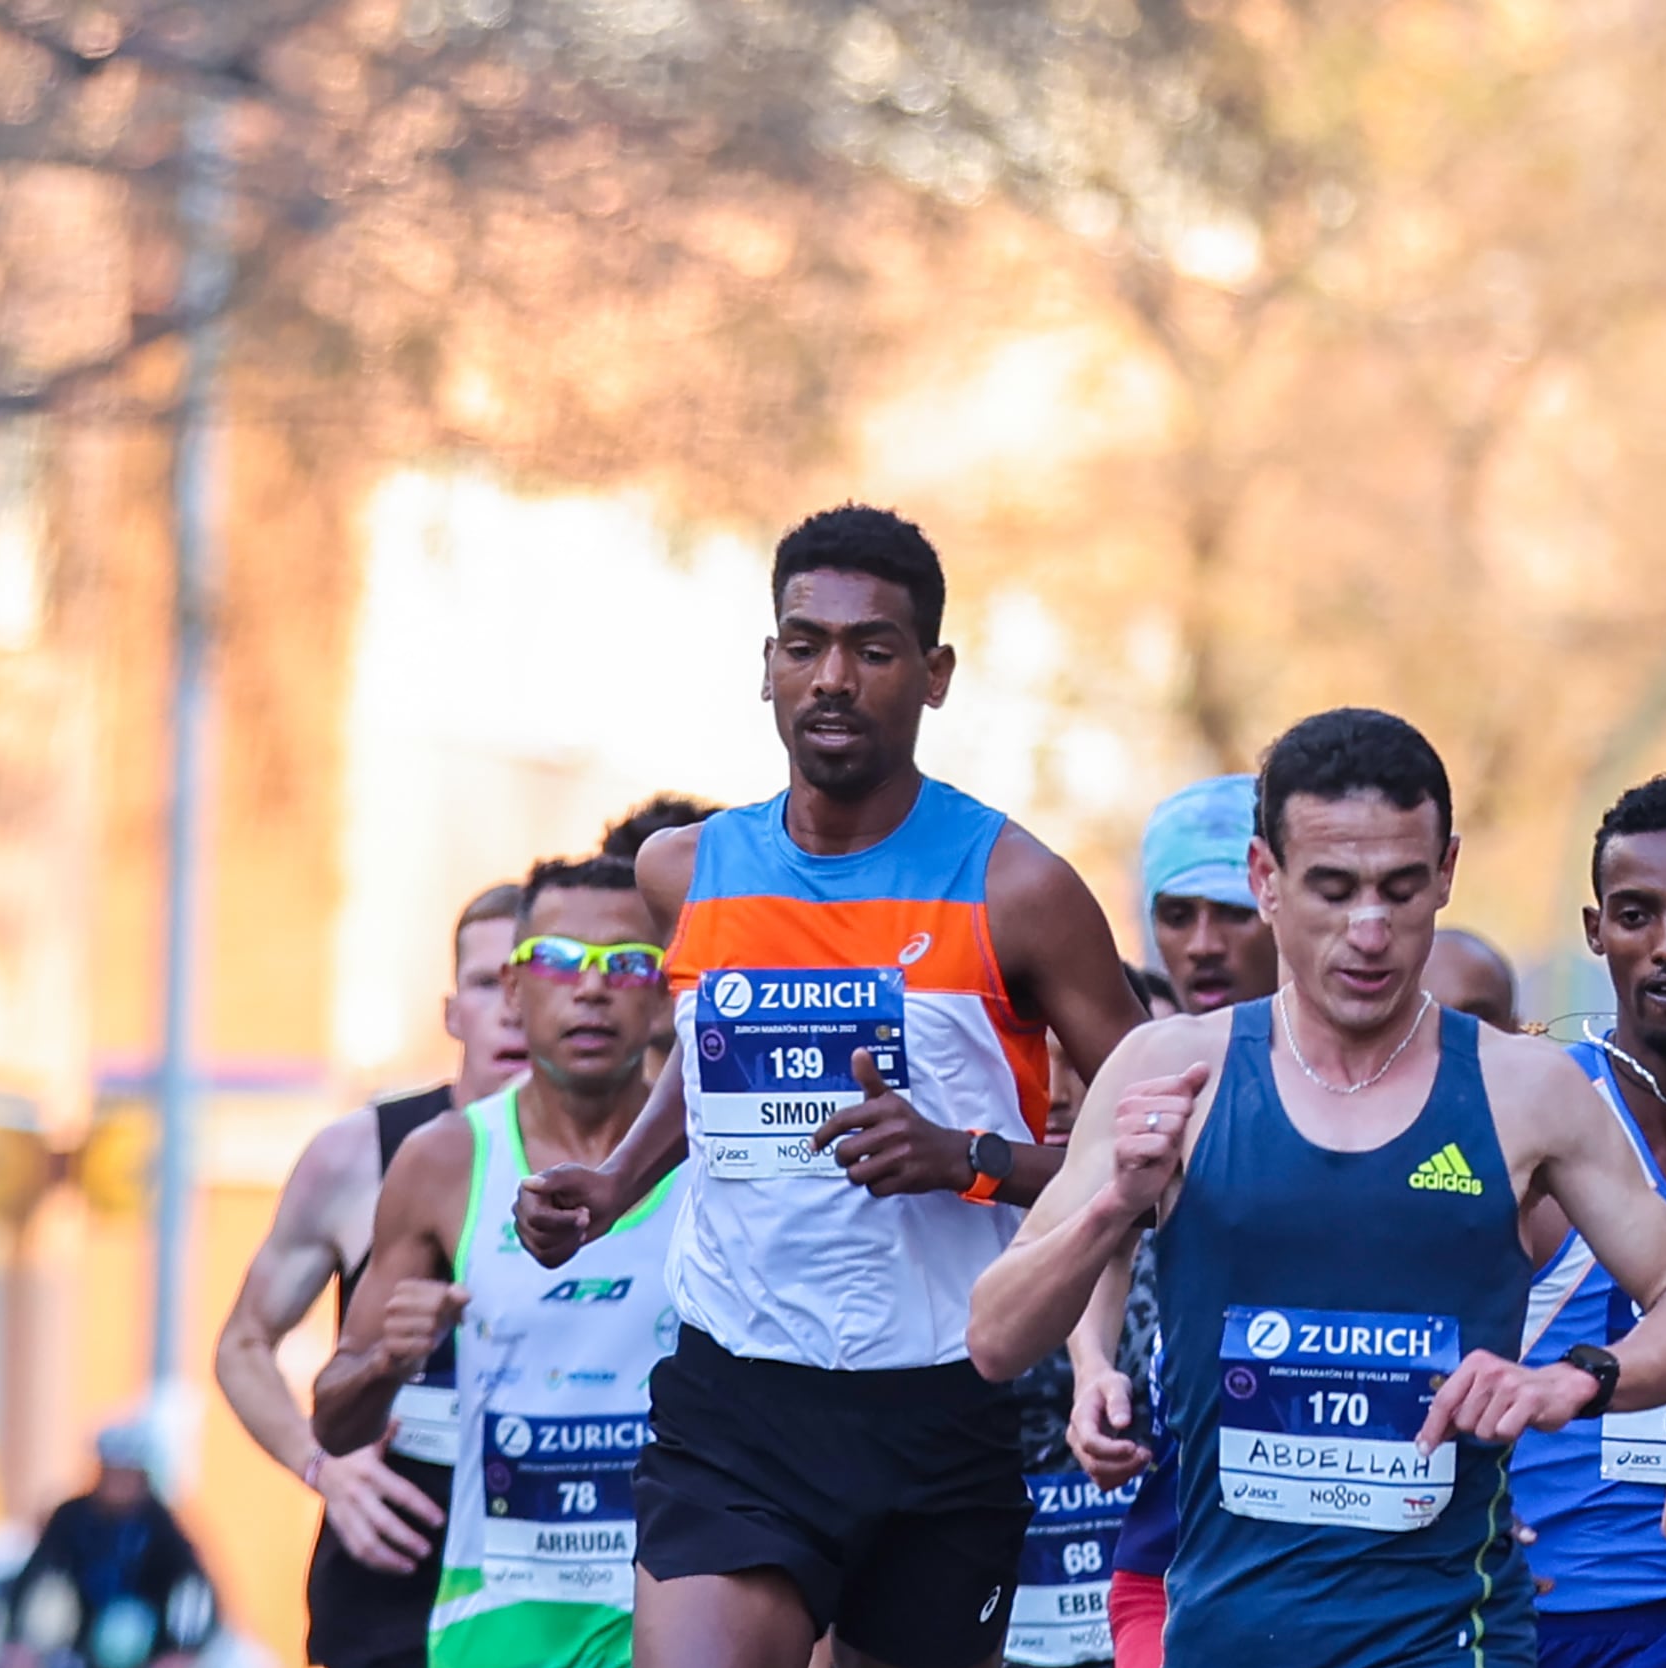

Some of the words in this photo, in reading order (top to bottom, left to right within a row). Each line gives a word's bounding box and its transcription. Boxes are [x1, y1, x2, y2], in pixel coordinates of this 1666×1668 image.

[759, 980, 877, 1009] ZURICH
[770, 1047, 824, 1079] 139
[761, 1101, 836, 1125] SIMON
[1408, 1170, 1483, 1195] adidas
[1298, 1325, 1432, 1358] ZURICH
[1308, 1391, 1369, 1426] 170
[1248, 1438, 1430, 1479] ABDELLAH
[1631, 1454, 1660, 1466] asics
[557, 1481, 597, 1514] 78
[1248, 1488, 1277, 1500] asics
[536, 1530, 626, 1552] ARRUDA
[1063, 1541, 1102, 1575] 68
[1058, 1592, 1103, 1617] EBB
